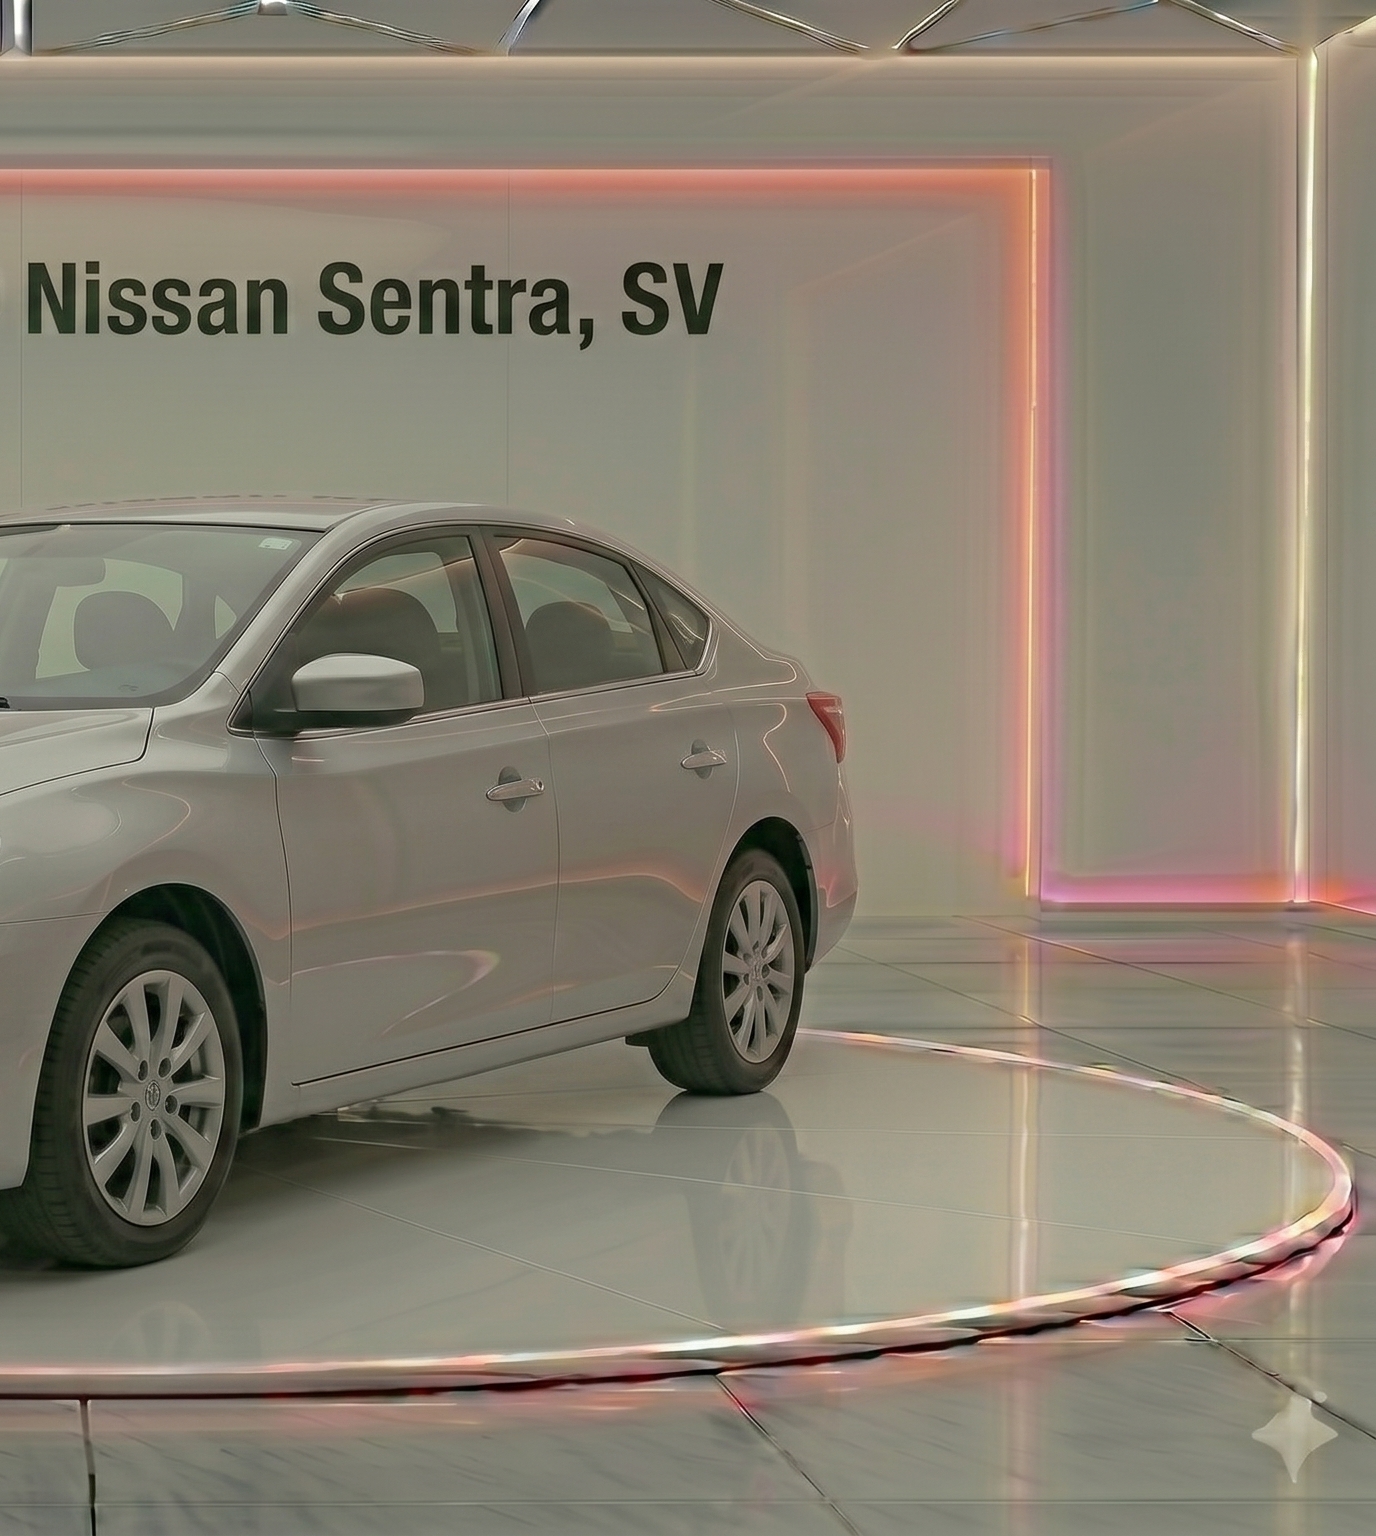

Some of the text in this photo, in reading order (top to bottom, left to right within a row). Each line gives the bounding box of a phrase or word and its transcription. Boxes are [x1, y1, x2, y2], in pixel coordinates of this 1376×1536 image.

[27, 260, 288, 336] Nissan
[317, 261, 594, 351] Sentra,
[621, 261, 725, 336] SV
